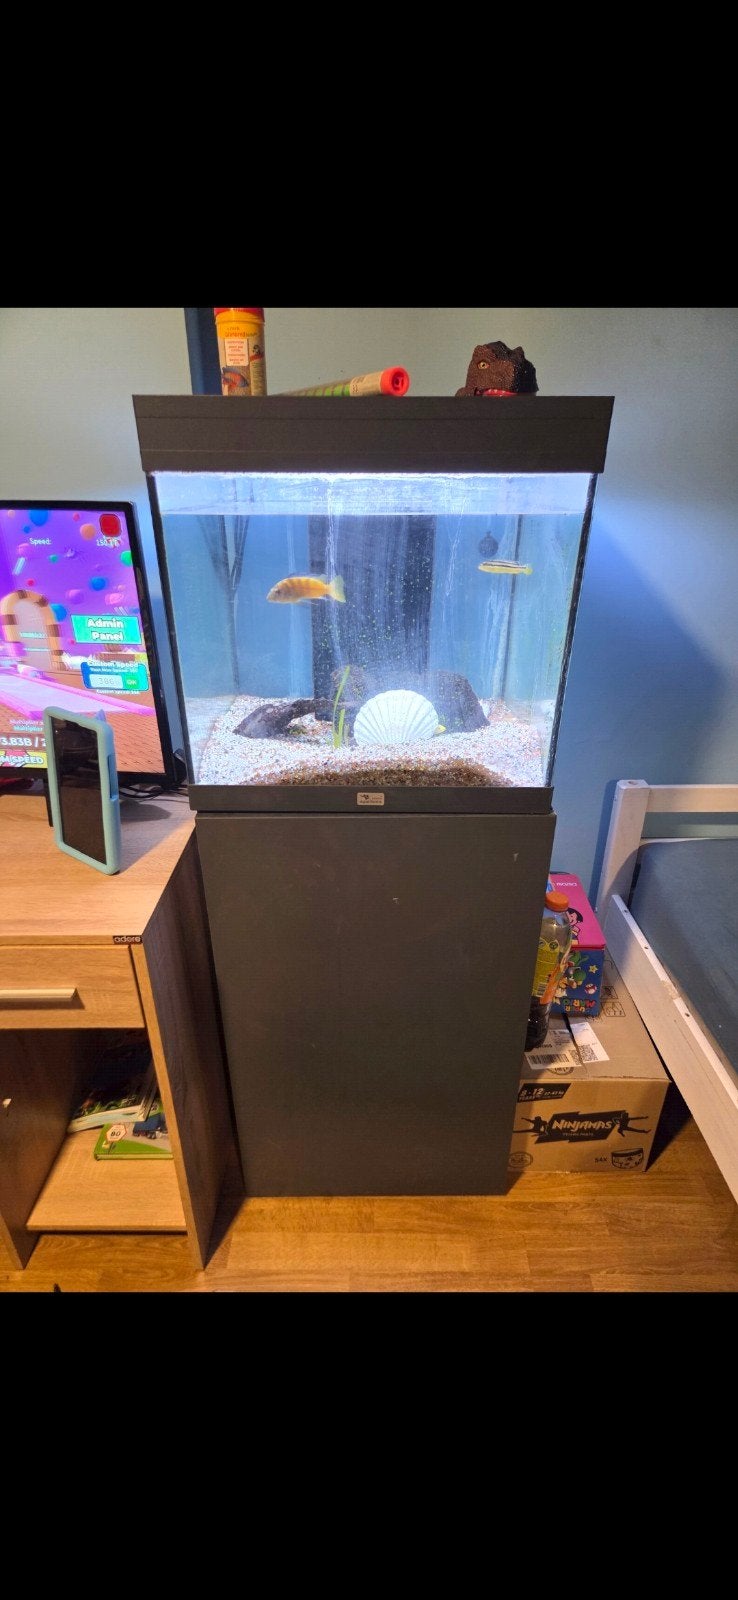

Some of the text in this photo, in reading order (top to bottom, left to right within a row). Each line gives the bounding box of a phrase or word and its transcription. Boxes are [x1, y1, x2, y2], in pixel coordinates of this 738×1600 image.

[87, 617, 124, 628] Admin
[91, 631, 124, 641] Panel
[562, 999, 596, 1008] MARIO
[532, 1087, 544, 1096] 12
[552, 1119, 613, 1132] NINJAMAS
